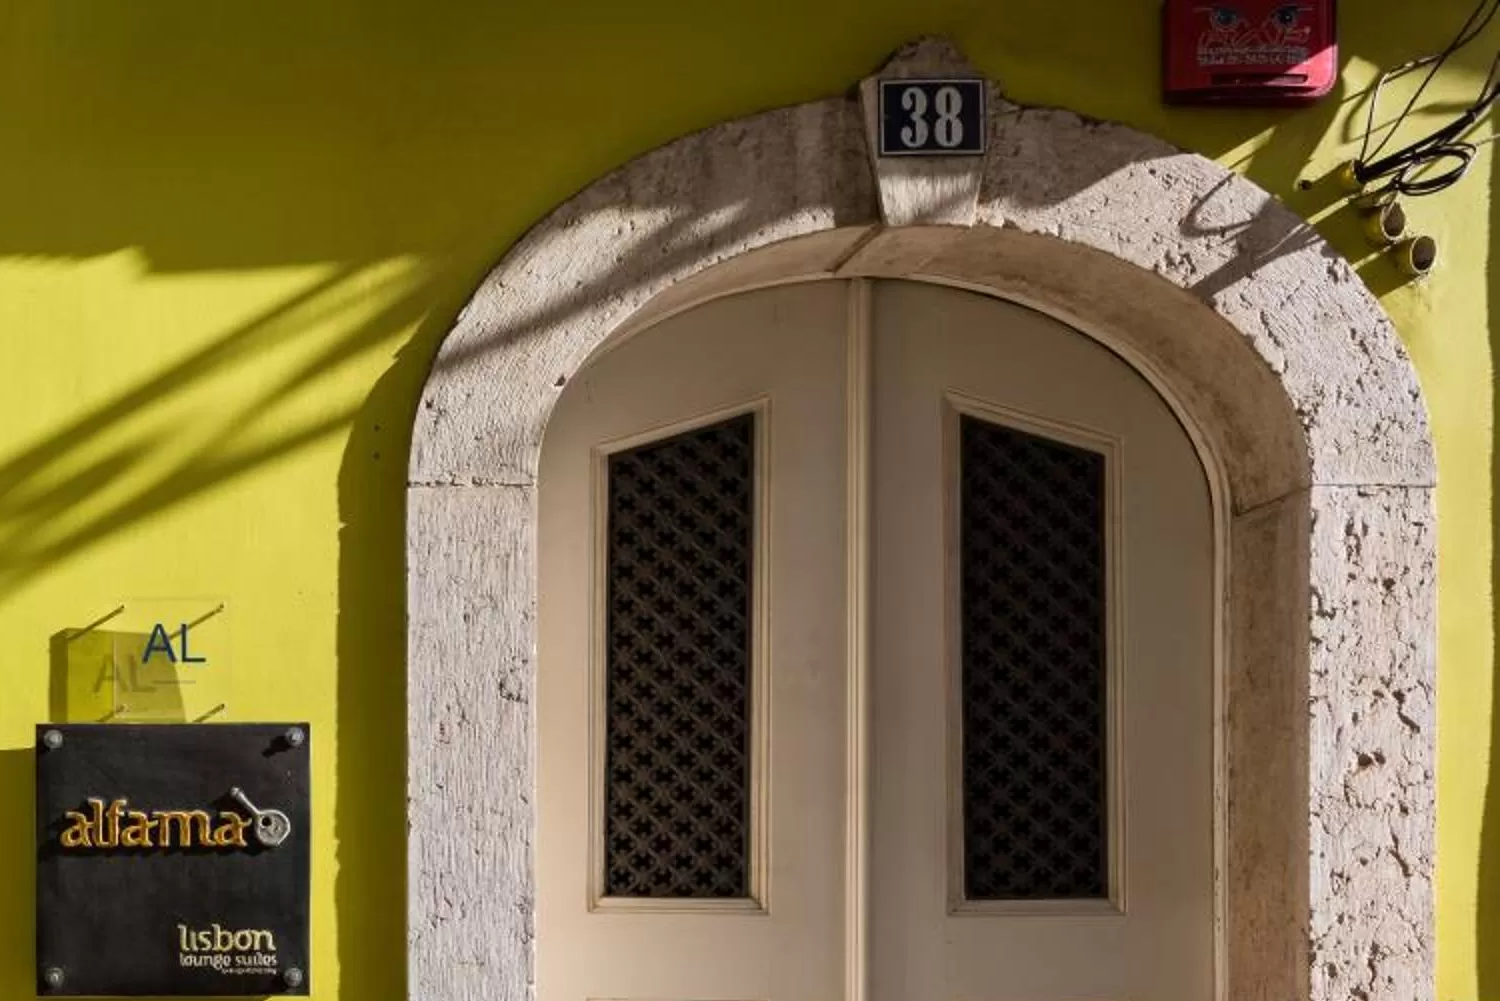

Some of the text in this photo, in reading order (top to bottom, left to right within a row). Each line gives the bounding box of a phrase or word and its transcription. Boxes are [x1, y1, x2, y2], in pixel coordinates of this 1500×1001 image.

[900, 86, 963, 148] 38
[142, 623, 207, 664] AL
[60, 796, 252, 848] alfama
[177, 923, 277, 952] lisbon
[179, 952, 231, 970] lounge
